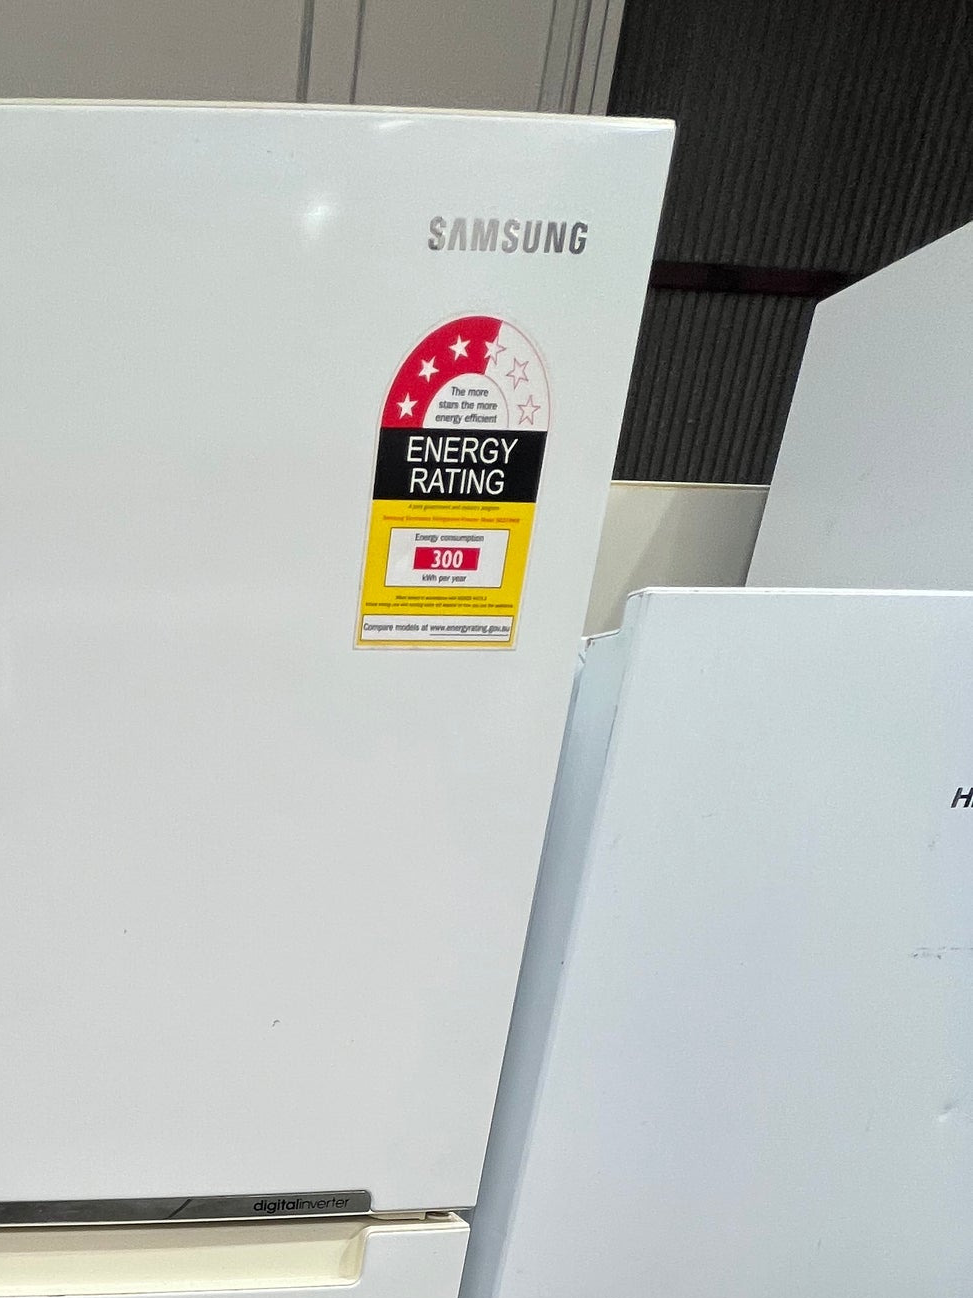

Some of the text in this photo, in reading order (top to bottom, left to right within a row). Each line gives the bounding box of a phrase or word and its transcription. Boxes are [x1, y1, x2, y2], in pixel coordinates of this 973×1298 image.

[428, 216, 589, 254] SAMSUNG
[451, 386, 489, 397] The more
[438, 400, 498, 411] stars the more
[435, 414, 498, 424] energy efficient
[407, 436, 519, 464] ENERGY
[409, 467, 505, 495] RATING
[415, 533, 485, 543] Energy consumption
[431, 550, 463, 568] 300
[363, 623, 393, 632] Compare
[395, 624, 419, 632] models
[421, 624, 428, 632] at
[253, 1197, 351, 1214] digitalinverter
